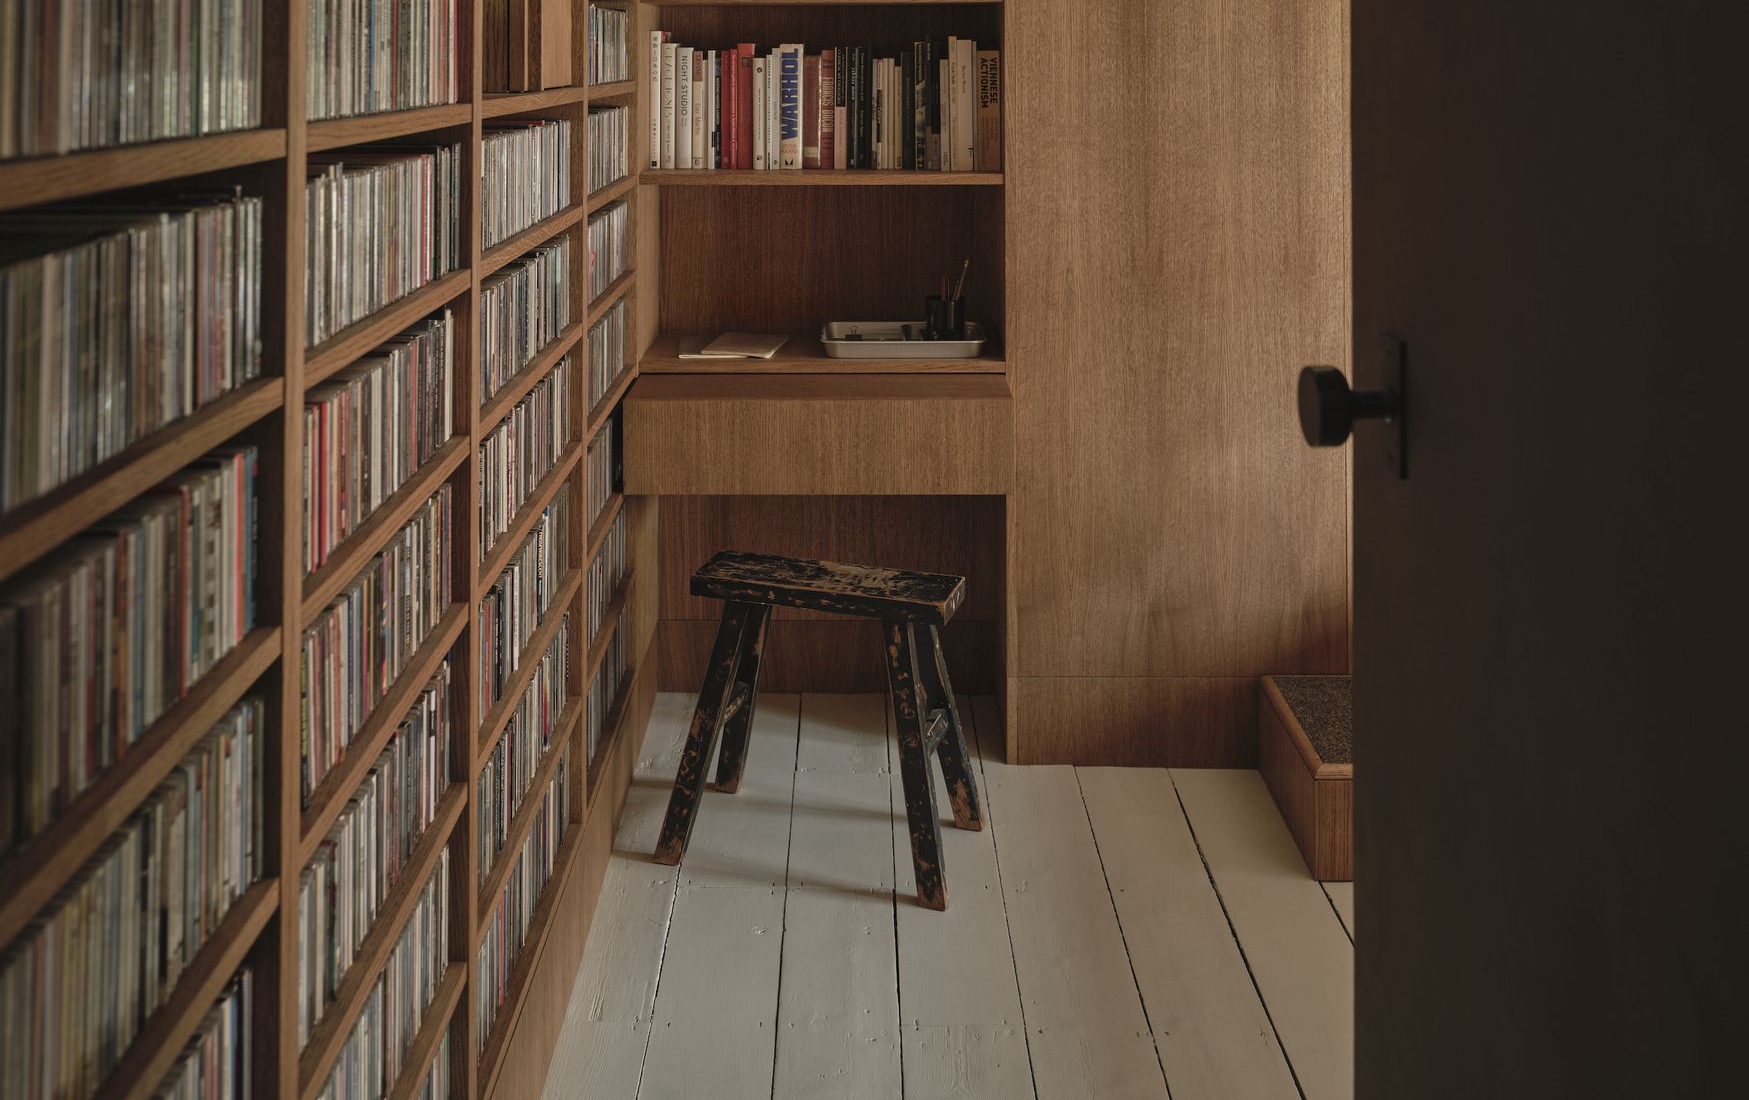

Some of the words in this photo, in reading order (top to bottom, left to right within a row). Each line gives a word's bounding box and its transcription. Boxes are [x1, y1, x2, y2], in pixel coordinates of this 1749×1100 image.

[781, 48, 799, 141] WARHOL
[822, 77, 834, 106] FRANCIS
[980, 57, 989, 108] ACTIONISM
[989, 57, 998, 104] VIENNESE
[822, 109, 834, 133] BACON
